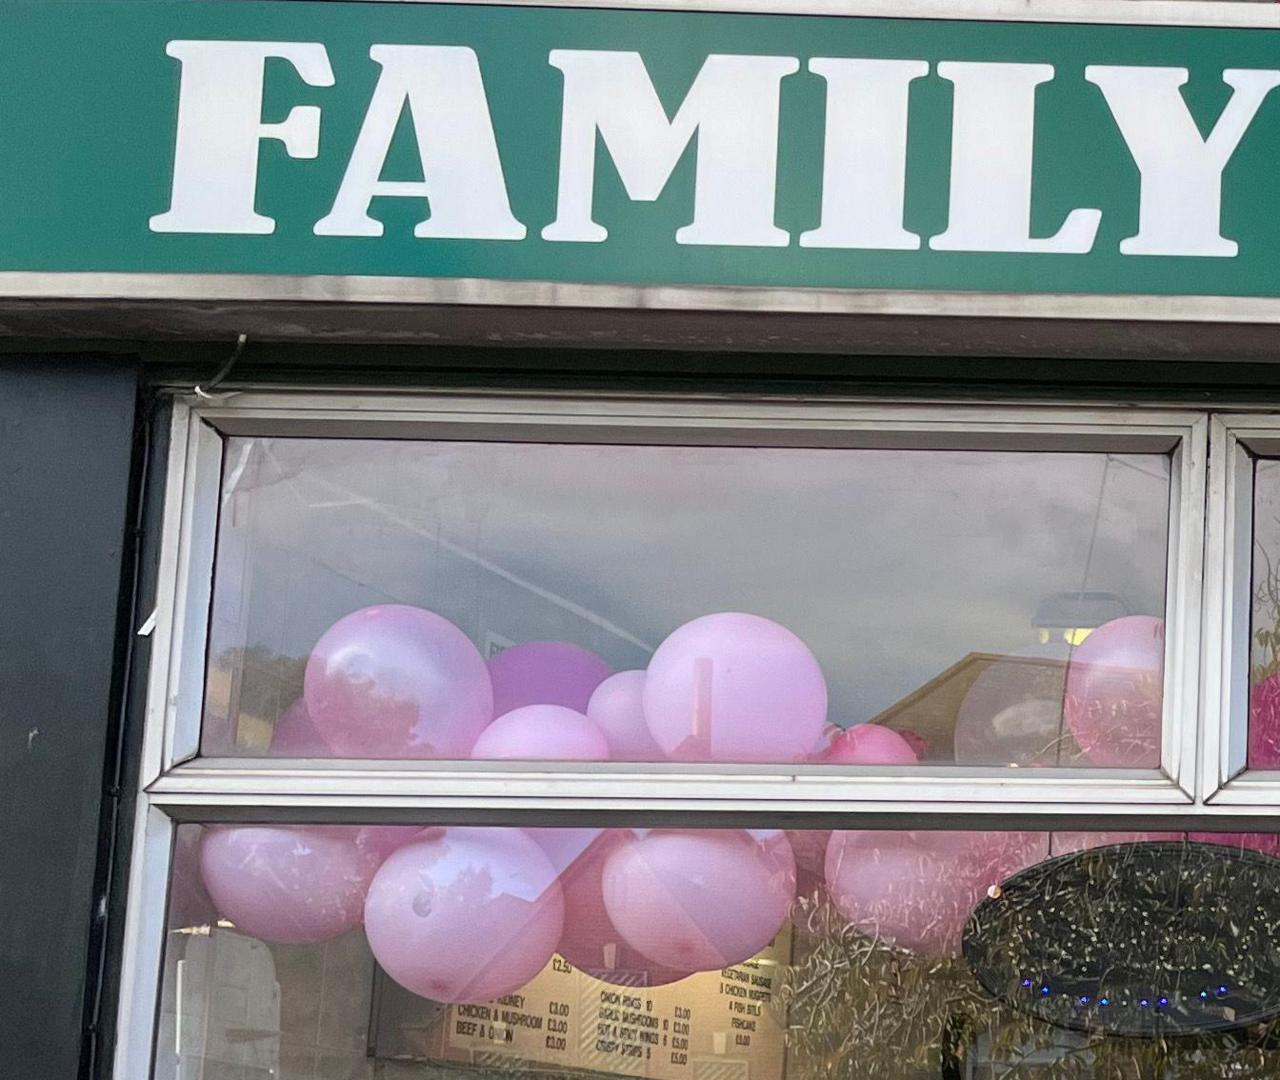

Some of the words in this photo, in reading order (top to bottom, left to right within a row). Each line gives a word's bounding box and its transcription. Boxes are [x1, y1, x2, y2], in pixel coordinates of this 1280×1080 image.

[458, 1004, 491, 1021] CHICKEN
[501, 1011, 543, 1029] MUSHROOM
[456, 1020, 478, 1035] BEEF
